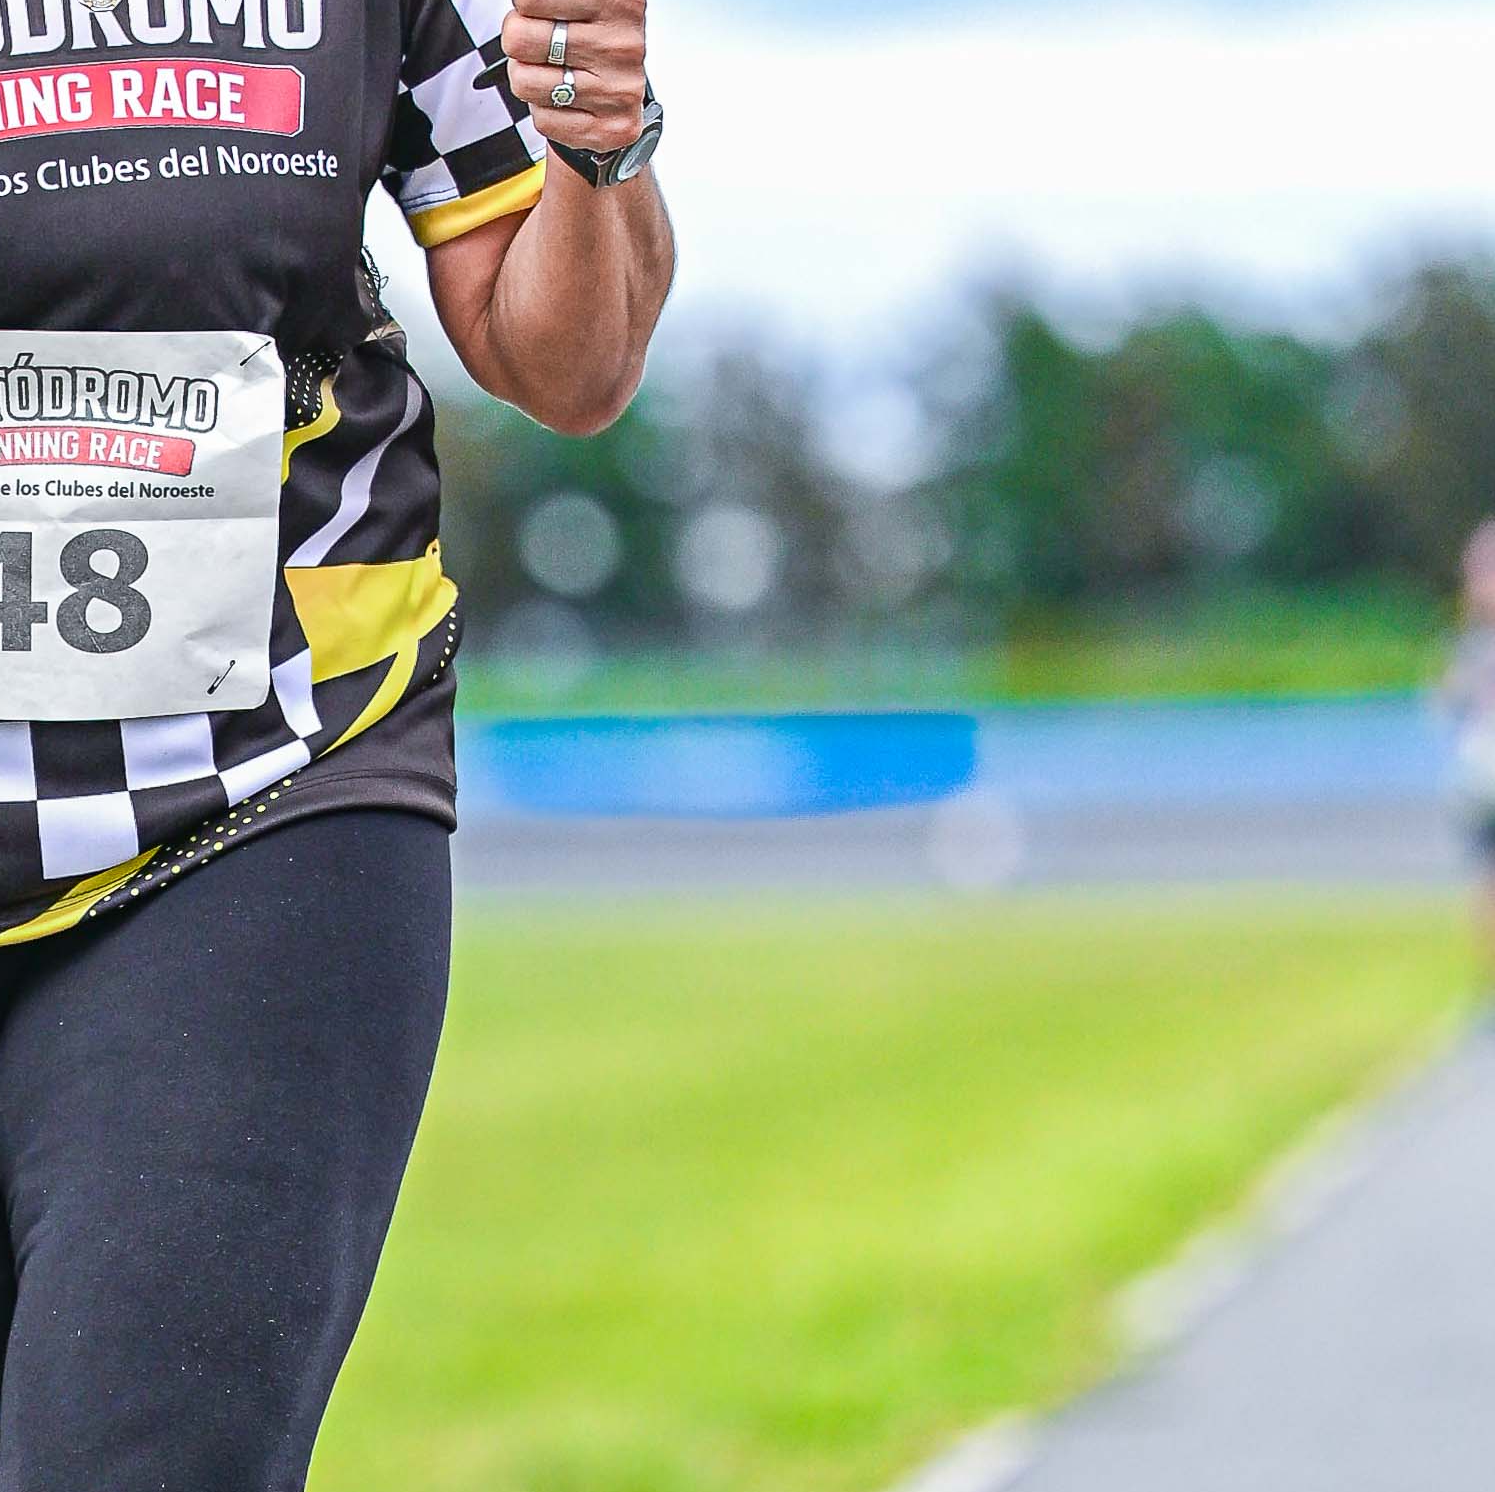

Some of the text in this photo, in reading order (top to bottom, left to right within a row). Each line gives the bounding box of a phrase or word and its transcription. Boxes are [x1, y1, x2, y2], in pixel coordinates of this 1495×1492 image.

[109, 67, 246, 124] RACE
[36, 154, 151, 191] Clubes
[158, 145, 210, 179] del
[217, 145, 339, 178] Noroeste
[89, 430, 164, 469] RACE
[16, 479, 40, 496] los
[45, 480, 103, 497] Clubes
[108, 481, 134, 498] del
[139, 482, 215, 498] Noroeste
